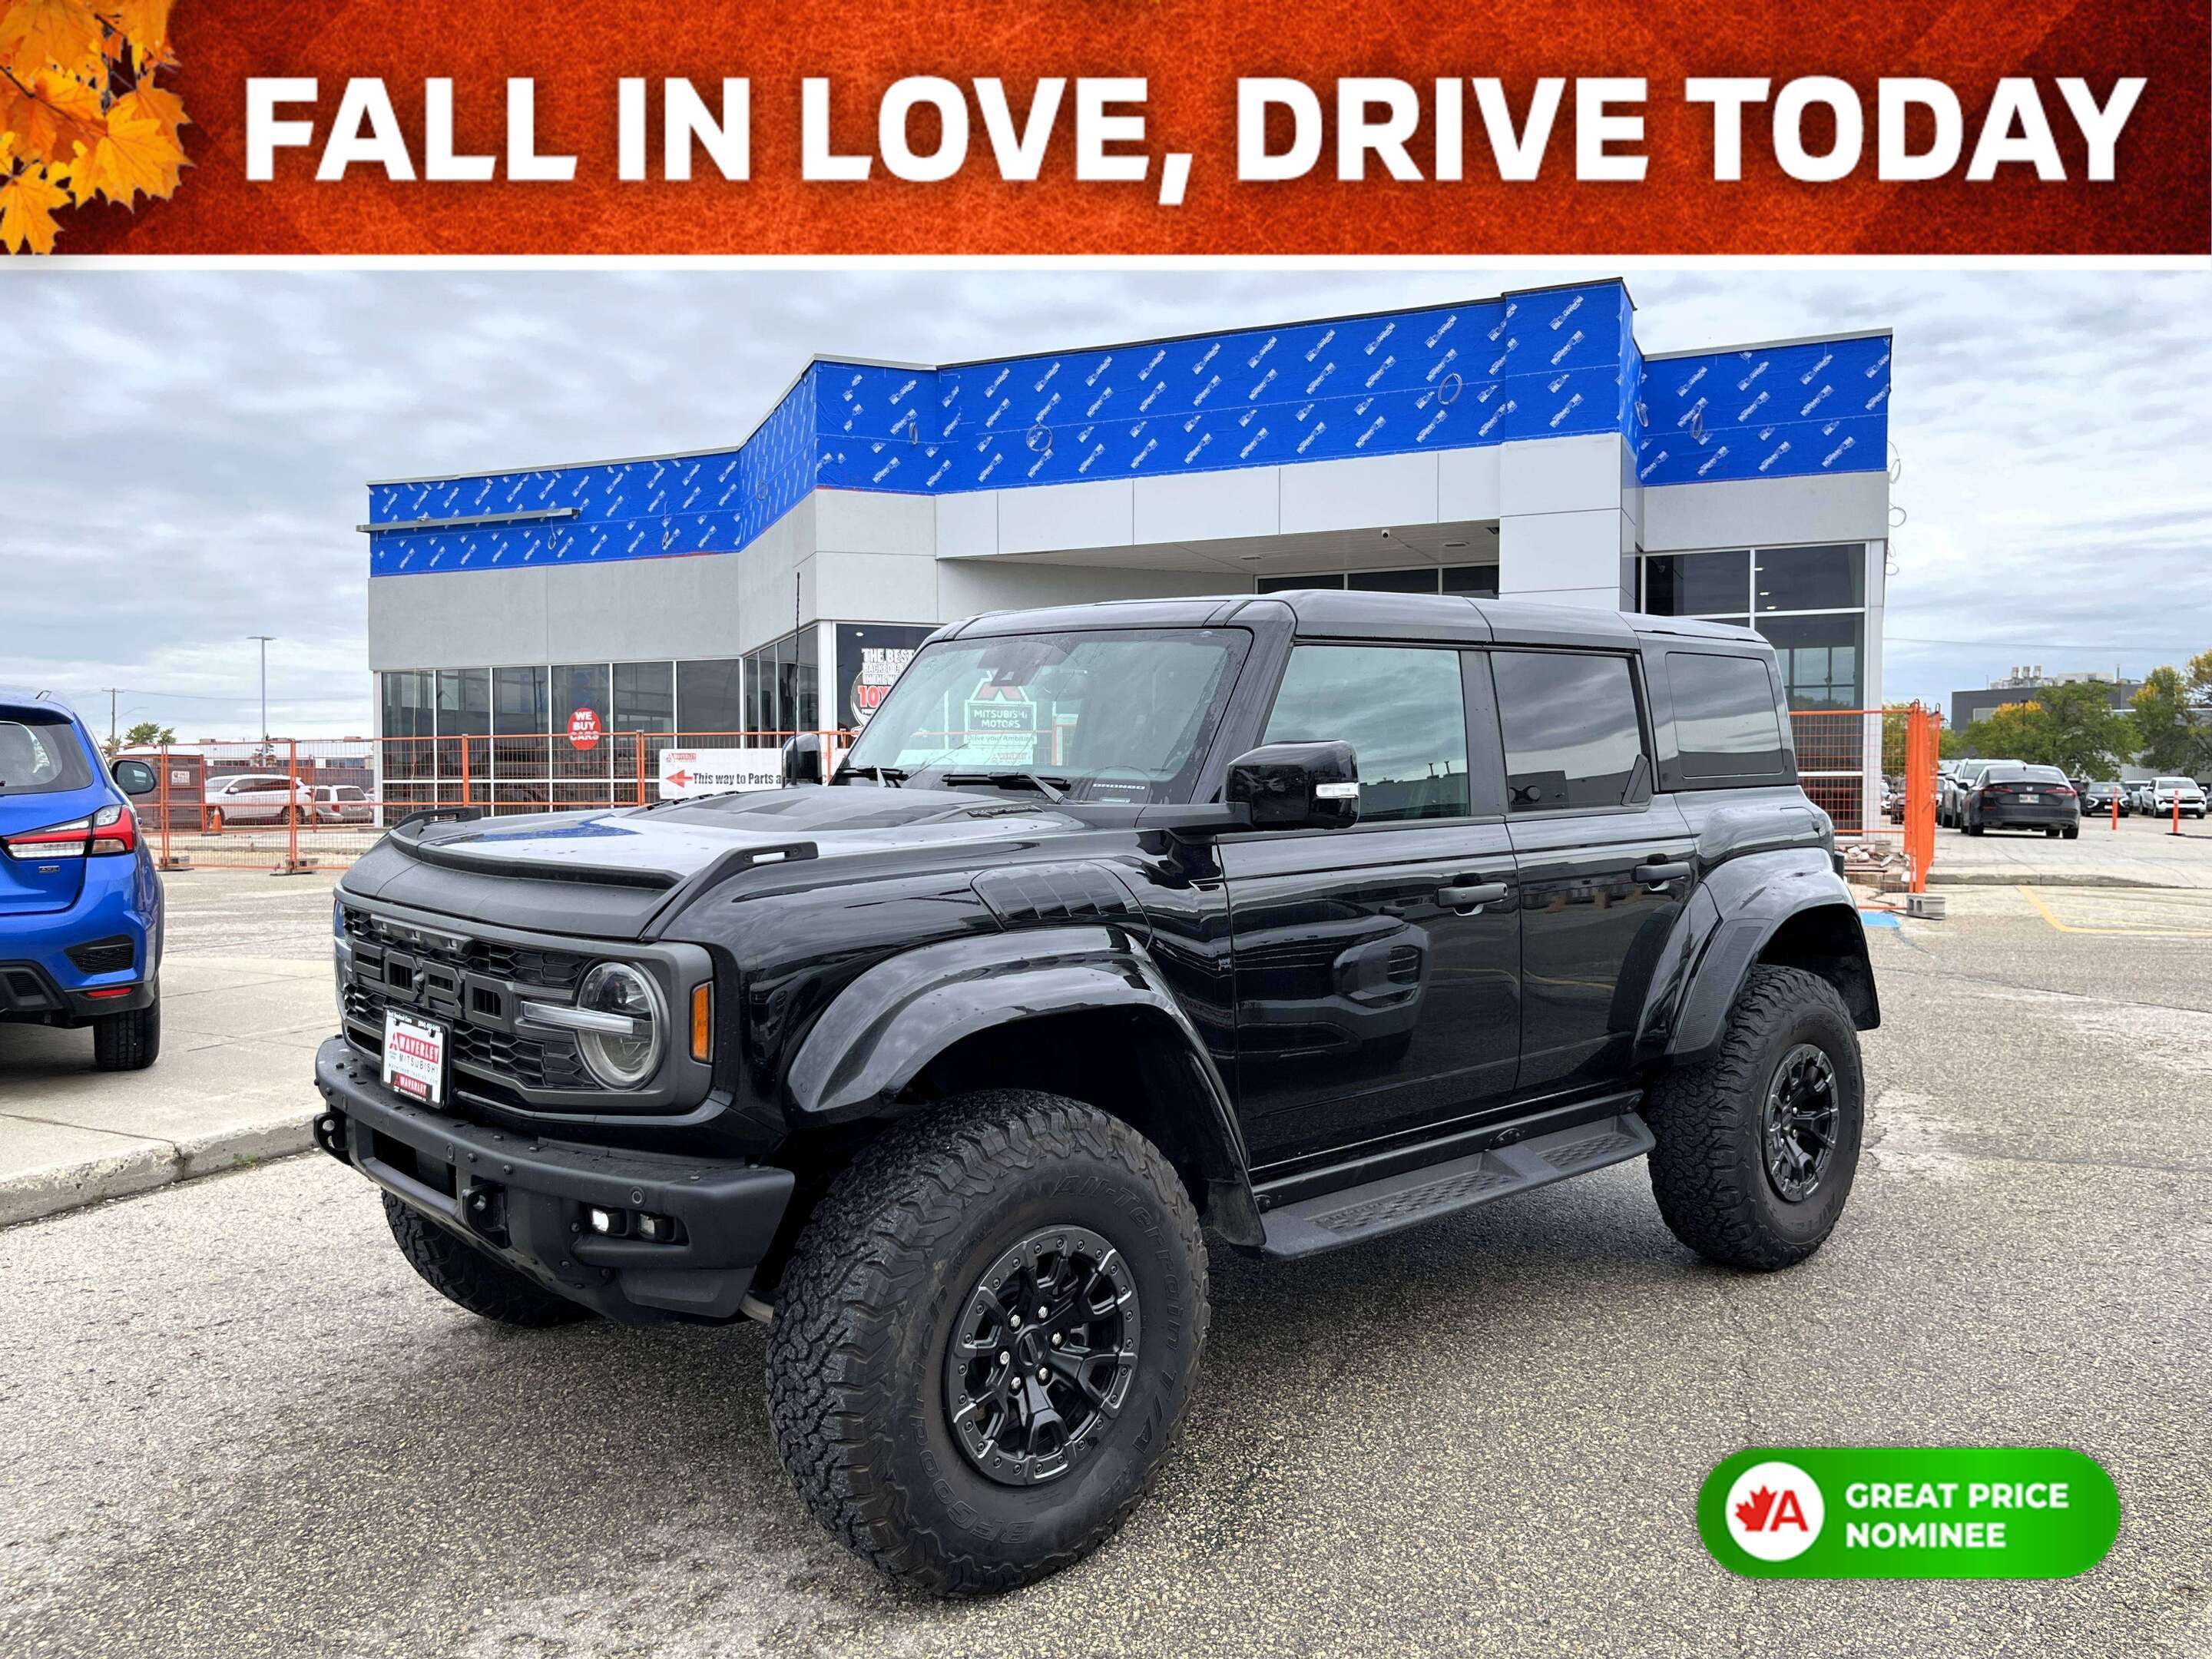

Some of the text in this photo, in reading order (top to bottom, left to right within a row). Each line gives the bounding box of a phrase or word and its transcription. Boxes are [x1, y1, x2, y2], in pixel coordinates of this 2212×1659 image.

[861, 648, 915, 663] THE BEST
[575, 711, 592, 720] WE
[974, 709, 1028, 719] MITSUBISHI
[573, 721, 595, 730] BUY
[982, 720, 1021, 728] MOTORS
[693, 773, 713, 784] This
[715, 774, 734, 786] way
[737, 773, 747, 784] to
[748, 773, 773, 784] Parts
[399, 1035, 439, 1063] WAVERLEY
